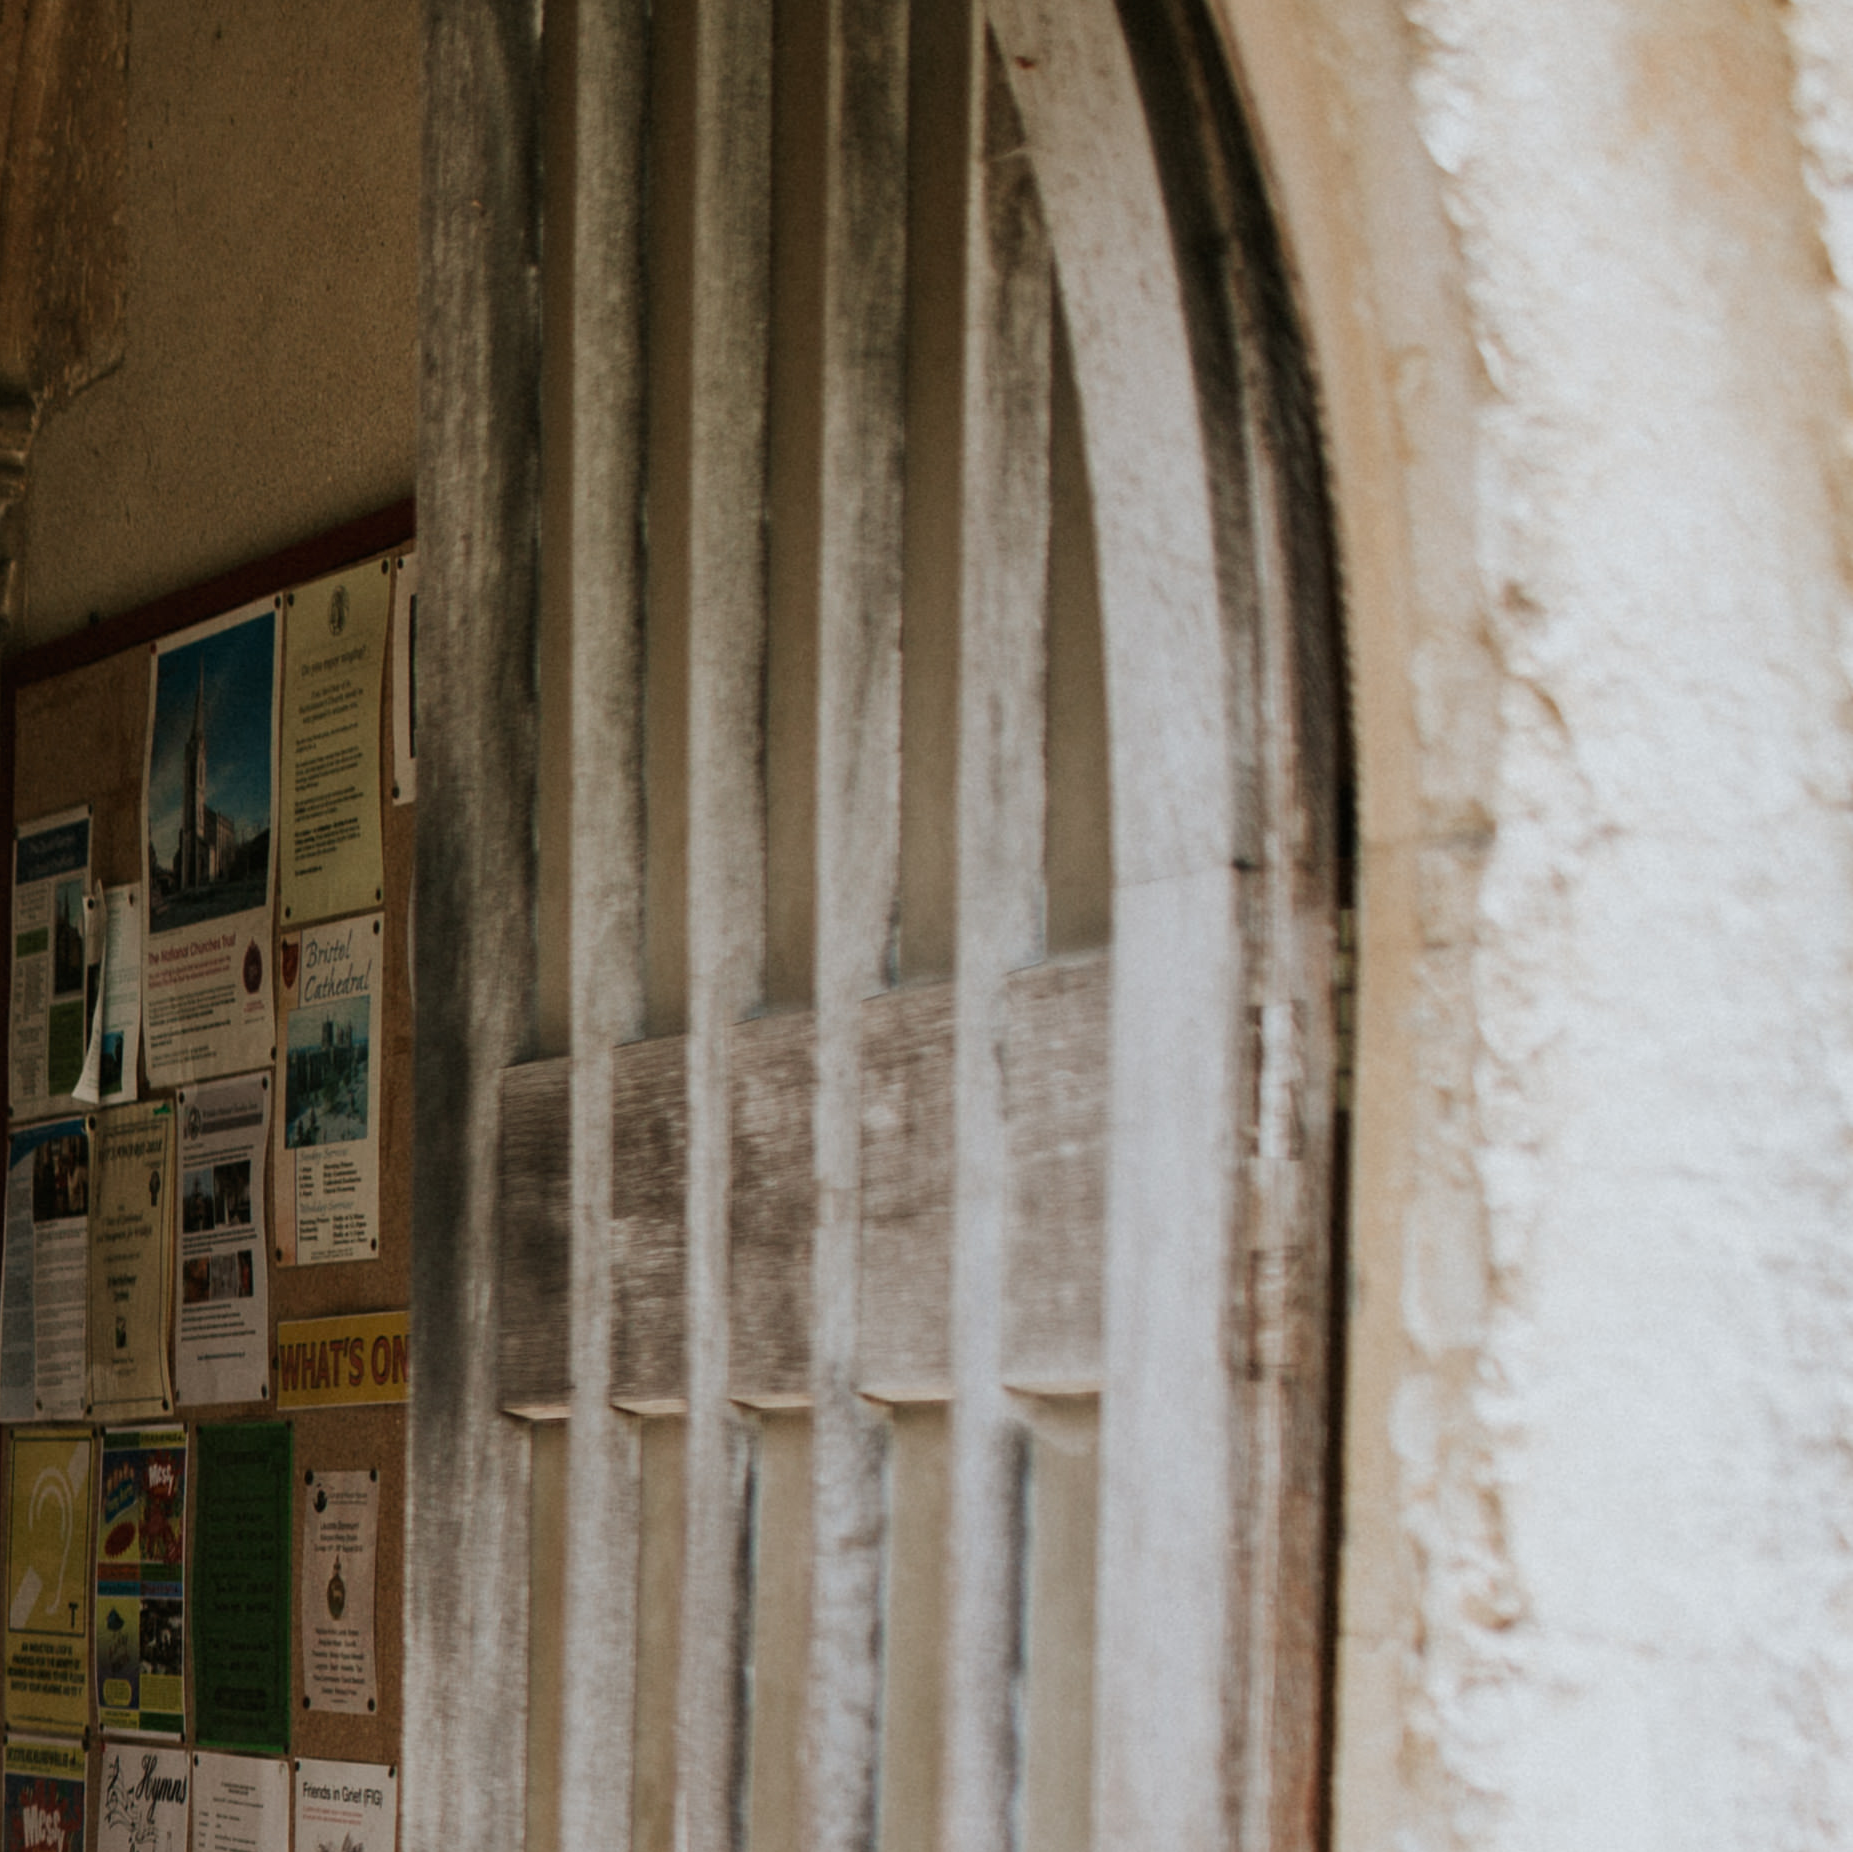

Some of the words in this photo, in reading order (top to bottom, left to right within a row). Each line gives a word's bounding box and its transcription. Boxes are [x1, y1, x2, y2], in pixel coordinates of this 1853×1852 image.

[148, 952, 160, 965] The
[161, 945, 189, 962] National
[190, 937, 221, 958] Churches
[222, 932, 237, 948] Trust
[305, 928, 353, 968] Bristol
[304, 959, 372, 1002] Cathedral
[279, 1336, 364, 1392] WHAT'S
[371, 1334, 410, 1386] ON
[68, 1602, 79, 1628] T
[134, 1755, 187, 1824] Hymns
[303, 1781, 331, 1800] Friends
[333, 1785, 340, 1801] in
[342, 1786, 362, 1803] Grief
[363, 1787, 383, 1809] (FIG)
